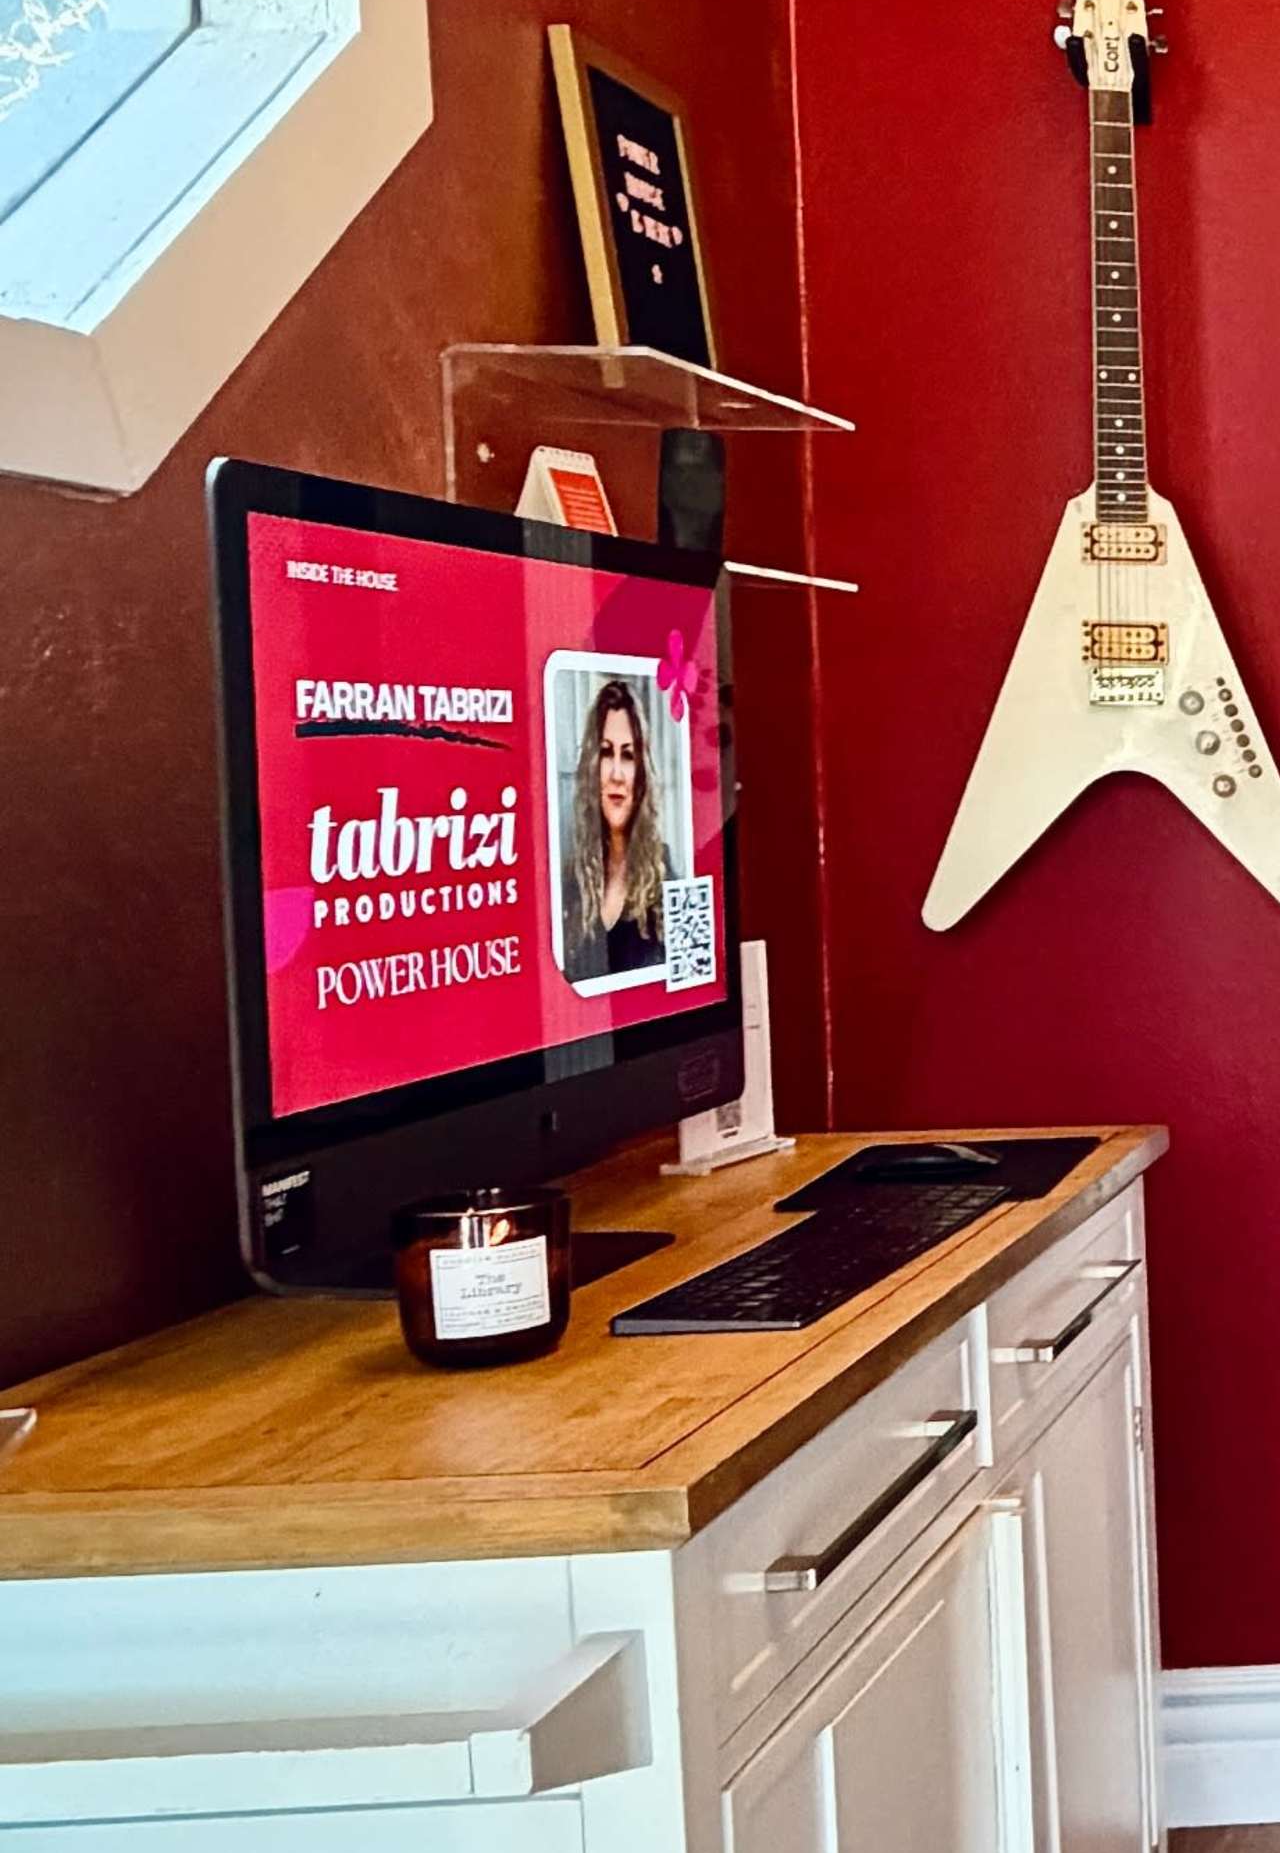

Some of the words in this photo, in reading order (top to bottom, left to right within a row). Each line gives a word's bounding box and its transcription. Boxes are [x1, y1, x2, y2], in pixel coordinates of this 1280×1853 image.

[286, 560, 329, 583] INSIDE
[330, 565, 355, 586] THE
[355, 569, 399, 592] HOUSE
[295, 679, 416, 721] FARRAN
[418, 685, 513, 723] TABRIZI
[307, 786, 518, 884] tabrizi
[313, 878, 518, 929] PRODUCTIONS
[316, 951, 428, 1010] POWER
[430, 936, 521, 988] HOUSE
[475, 1273, 506, 1286] The
